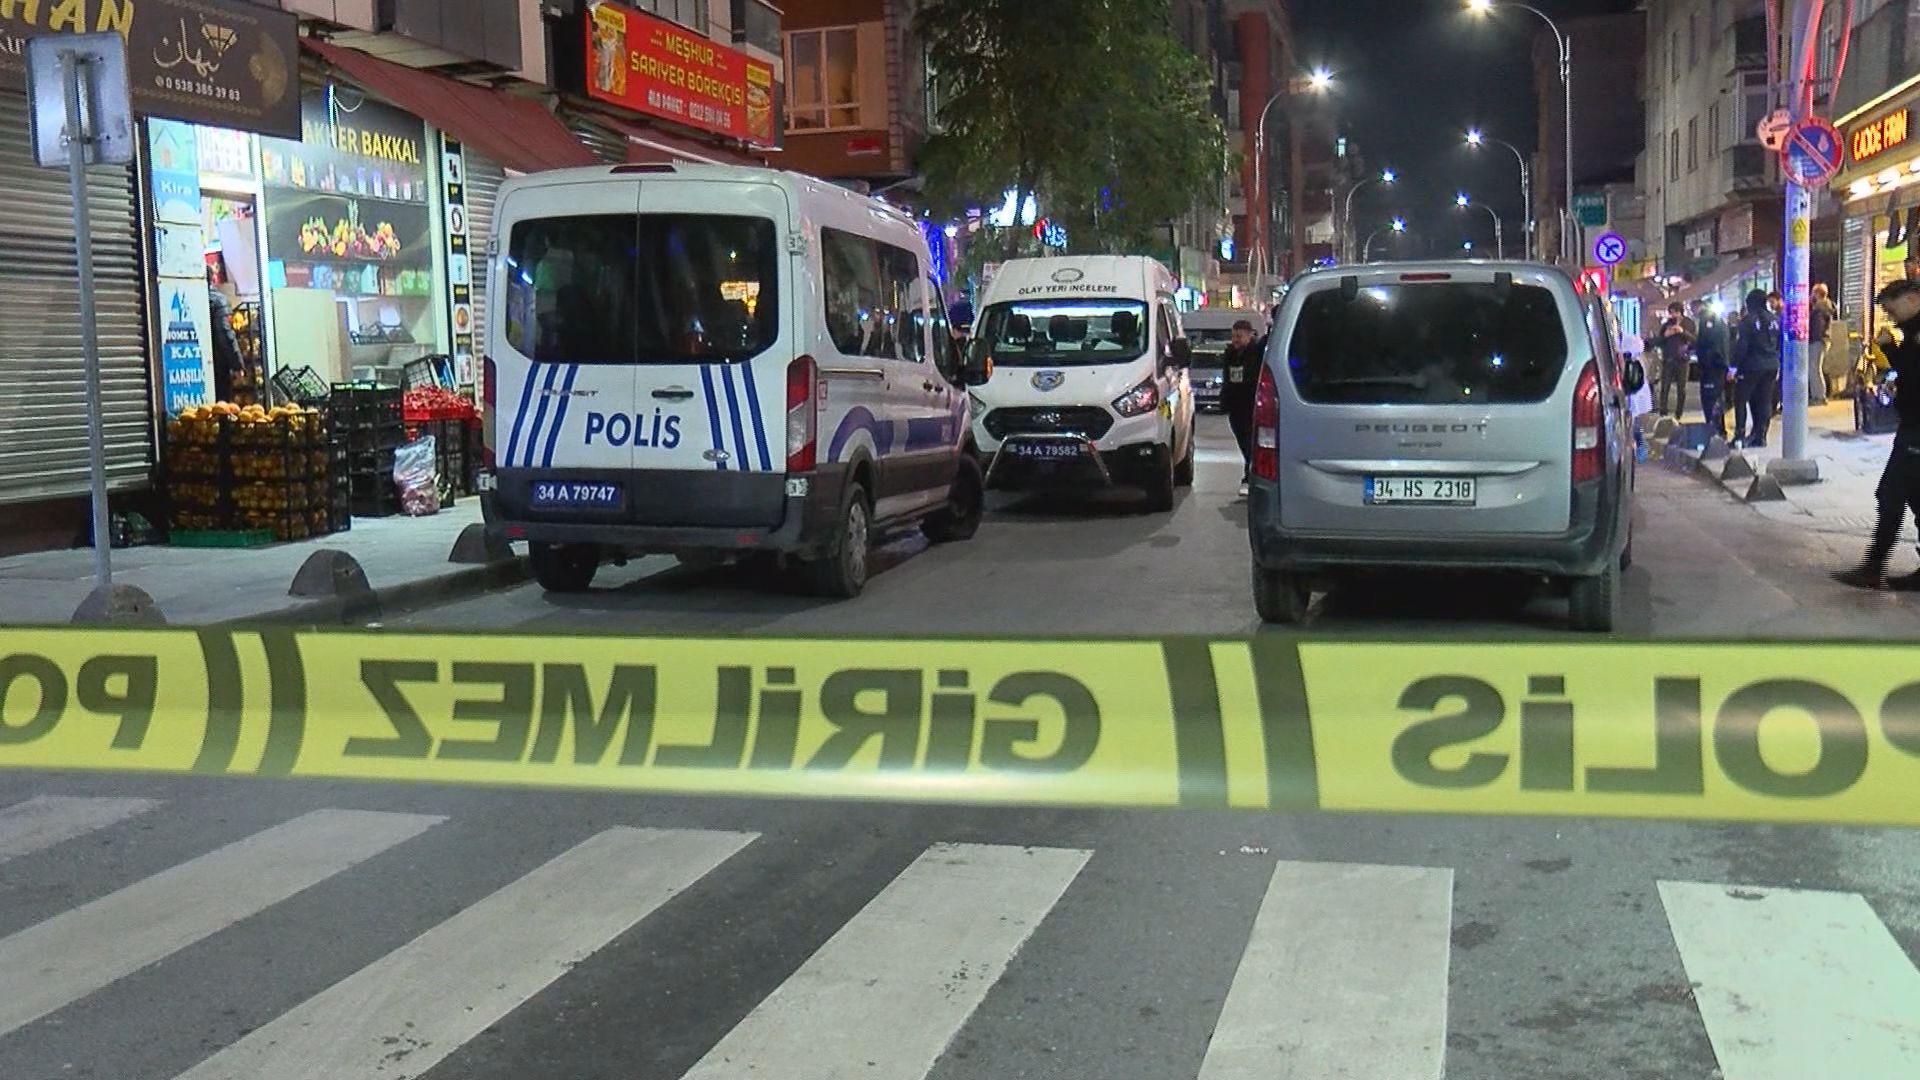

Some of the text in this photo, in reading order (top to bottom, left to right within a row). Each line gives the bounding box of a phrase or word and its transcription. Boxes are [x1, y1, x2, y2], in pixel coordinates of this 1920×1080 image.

[666, 33, 714, 67] MEŞHUR
[631, 51, 685, 88] SARIYER
[165, 77, 173, 89] 0
[302, 120, 420, 165] AKER BAKKAL
[1018, 286, 1043, 295] OLAY
[585, 407, 682, 450] POLİS
[1355, 424, 1488, 433] PEUGEOT
[1018, 446, 1032, 457] 34
[1033, 446, 1043, 457] A
[538, 485, 616, 501] 34 A 79747
[1375, 479, 1471, 498] 34 HS 2318
